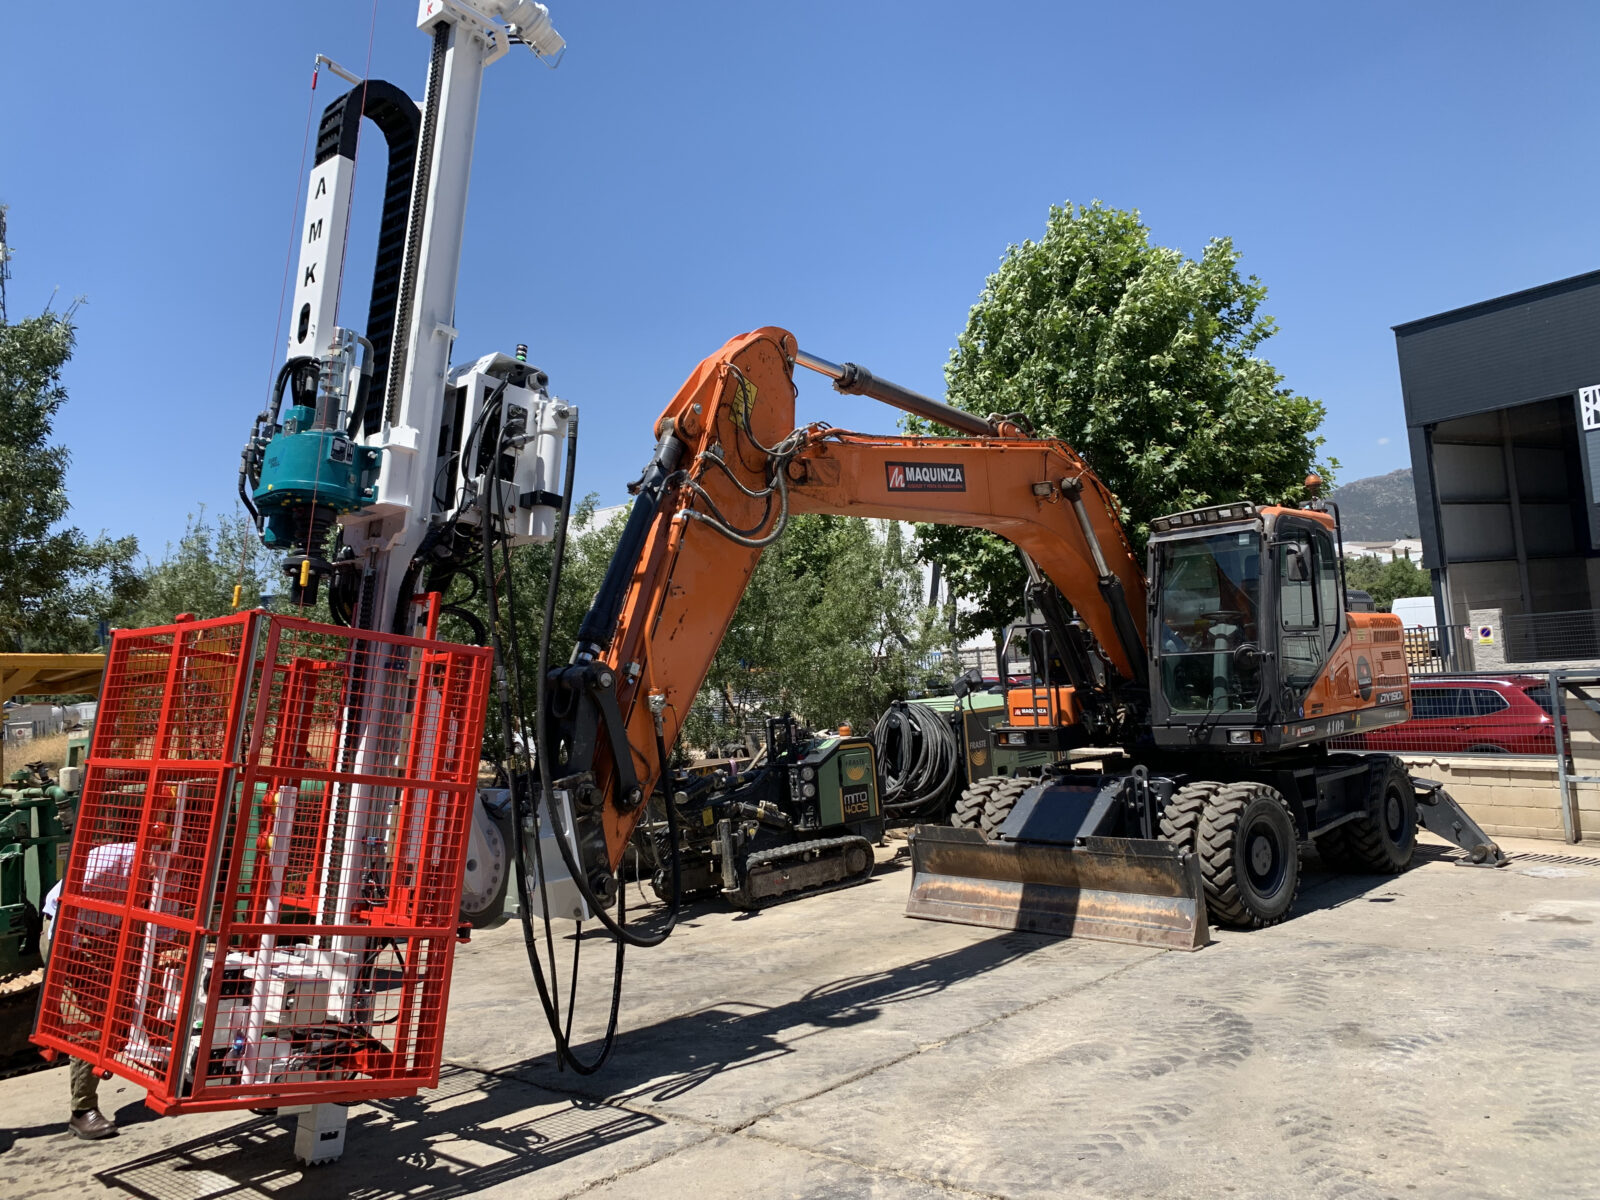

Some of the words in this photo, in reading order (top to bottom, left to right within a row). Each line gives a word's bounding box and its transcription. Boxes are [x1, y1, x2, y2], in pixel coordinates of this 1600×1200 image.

[905, 467, 963, 483] MAQUINZA
[1326, 720, 1345, 735] 4109
[969, 740, 986, 750] FRASTE
